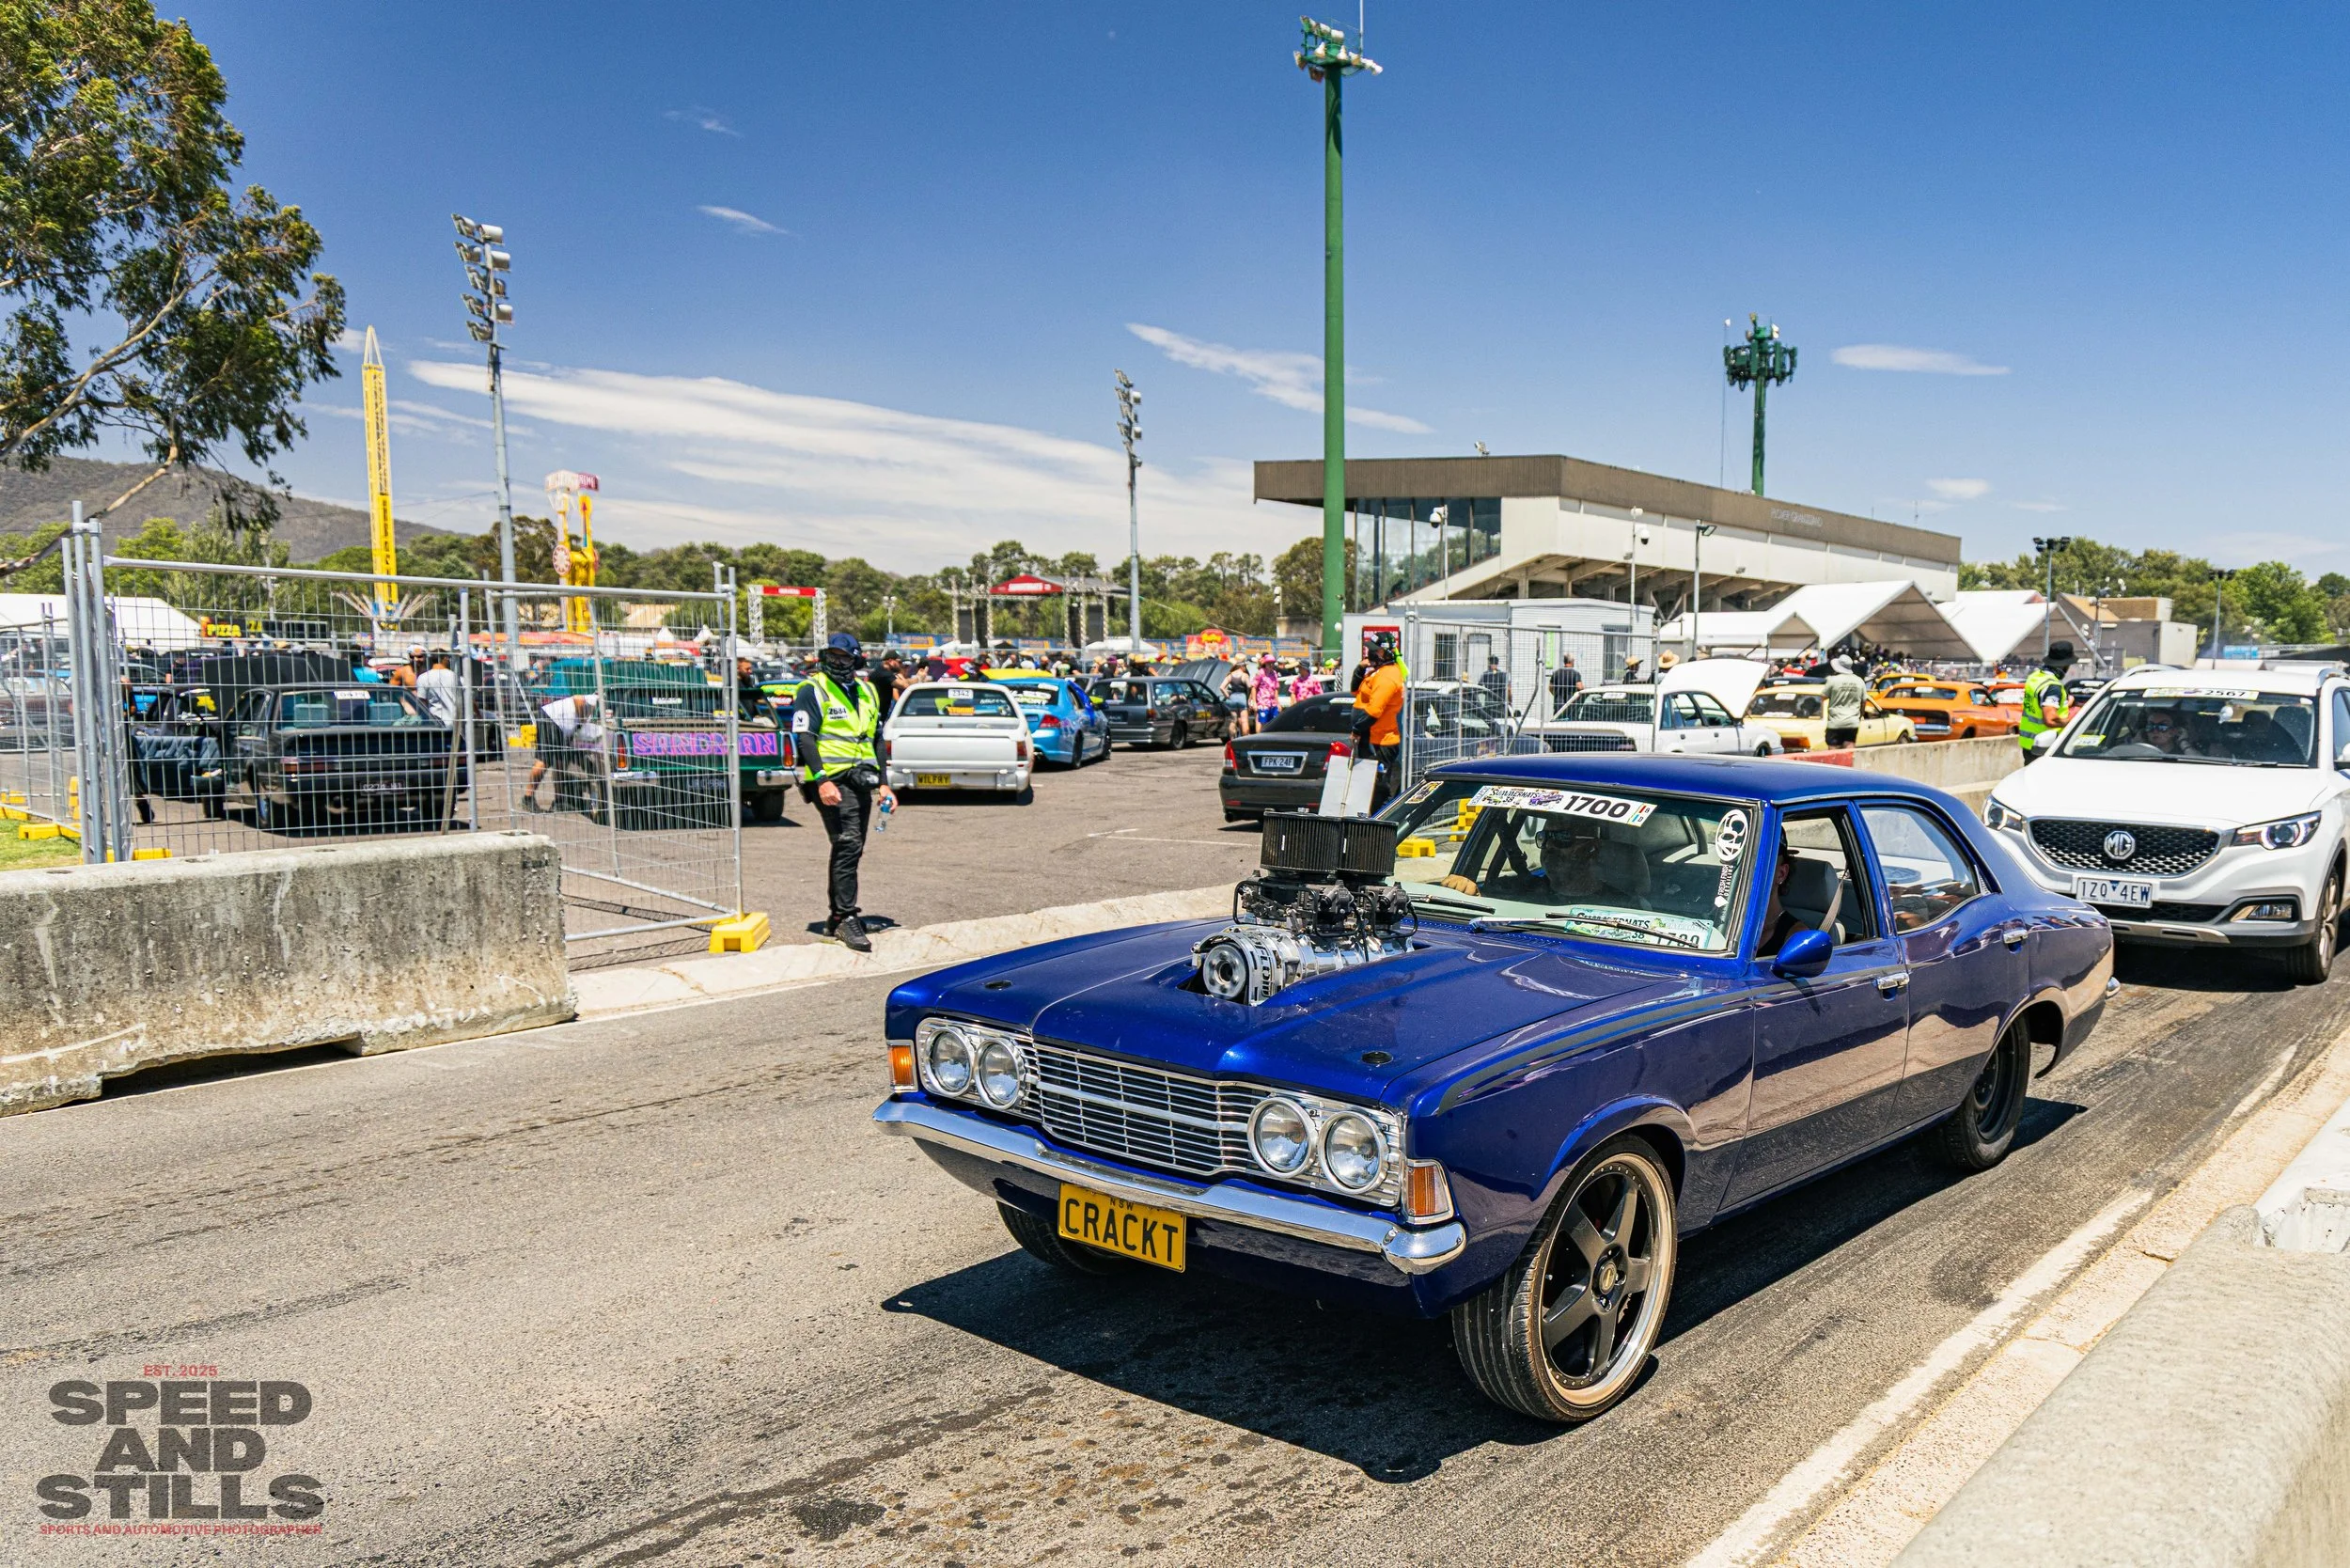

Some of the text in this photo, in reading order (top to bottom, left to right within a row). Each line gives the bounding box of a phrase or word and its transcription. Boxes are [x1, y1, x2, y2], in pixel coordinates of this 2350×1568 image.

[207, 623, 242, 637] PIZZA
[1492, 789, 1539, 798] SUMMERNATS
[1563, 795, 1631, 818] 1700
[2107, 833, 2132, 856] MG
[2120, 884, 2151, 902] 4EW
[1110, 1198, 1135, 1211] NSW
[1065, 1198, 1179, 1262] CRACKT
